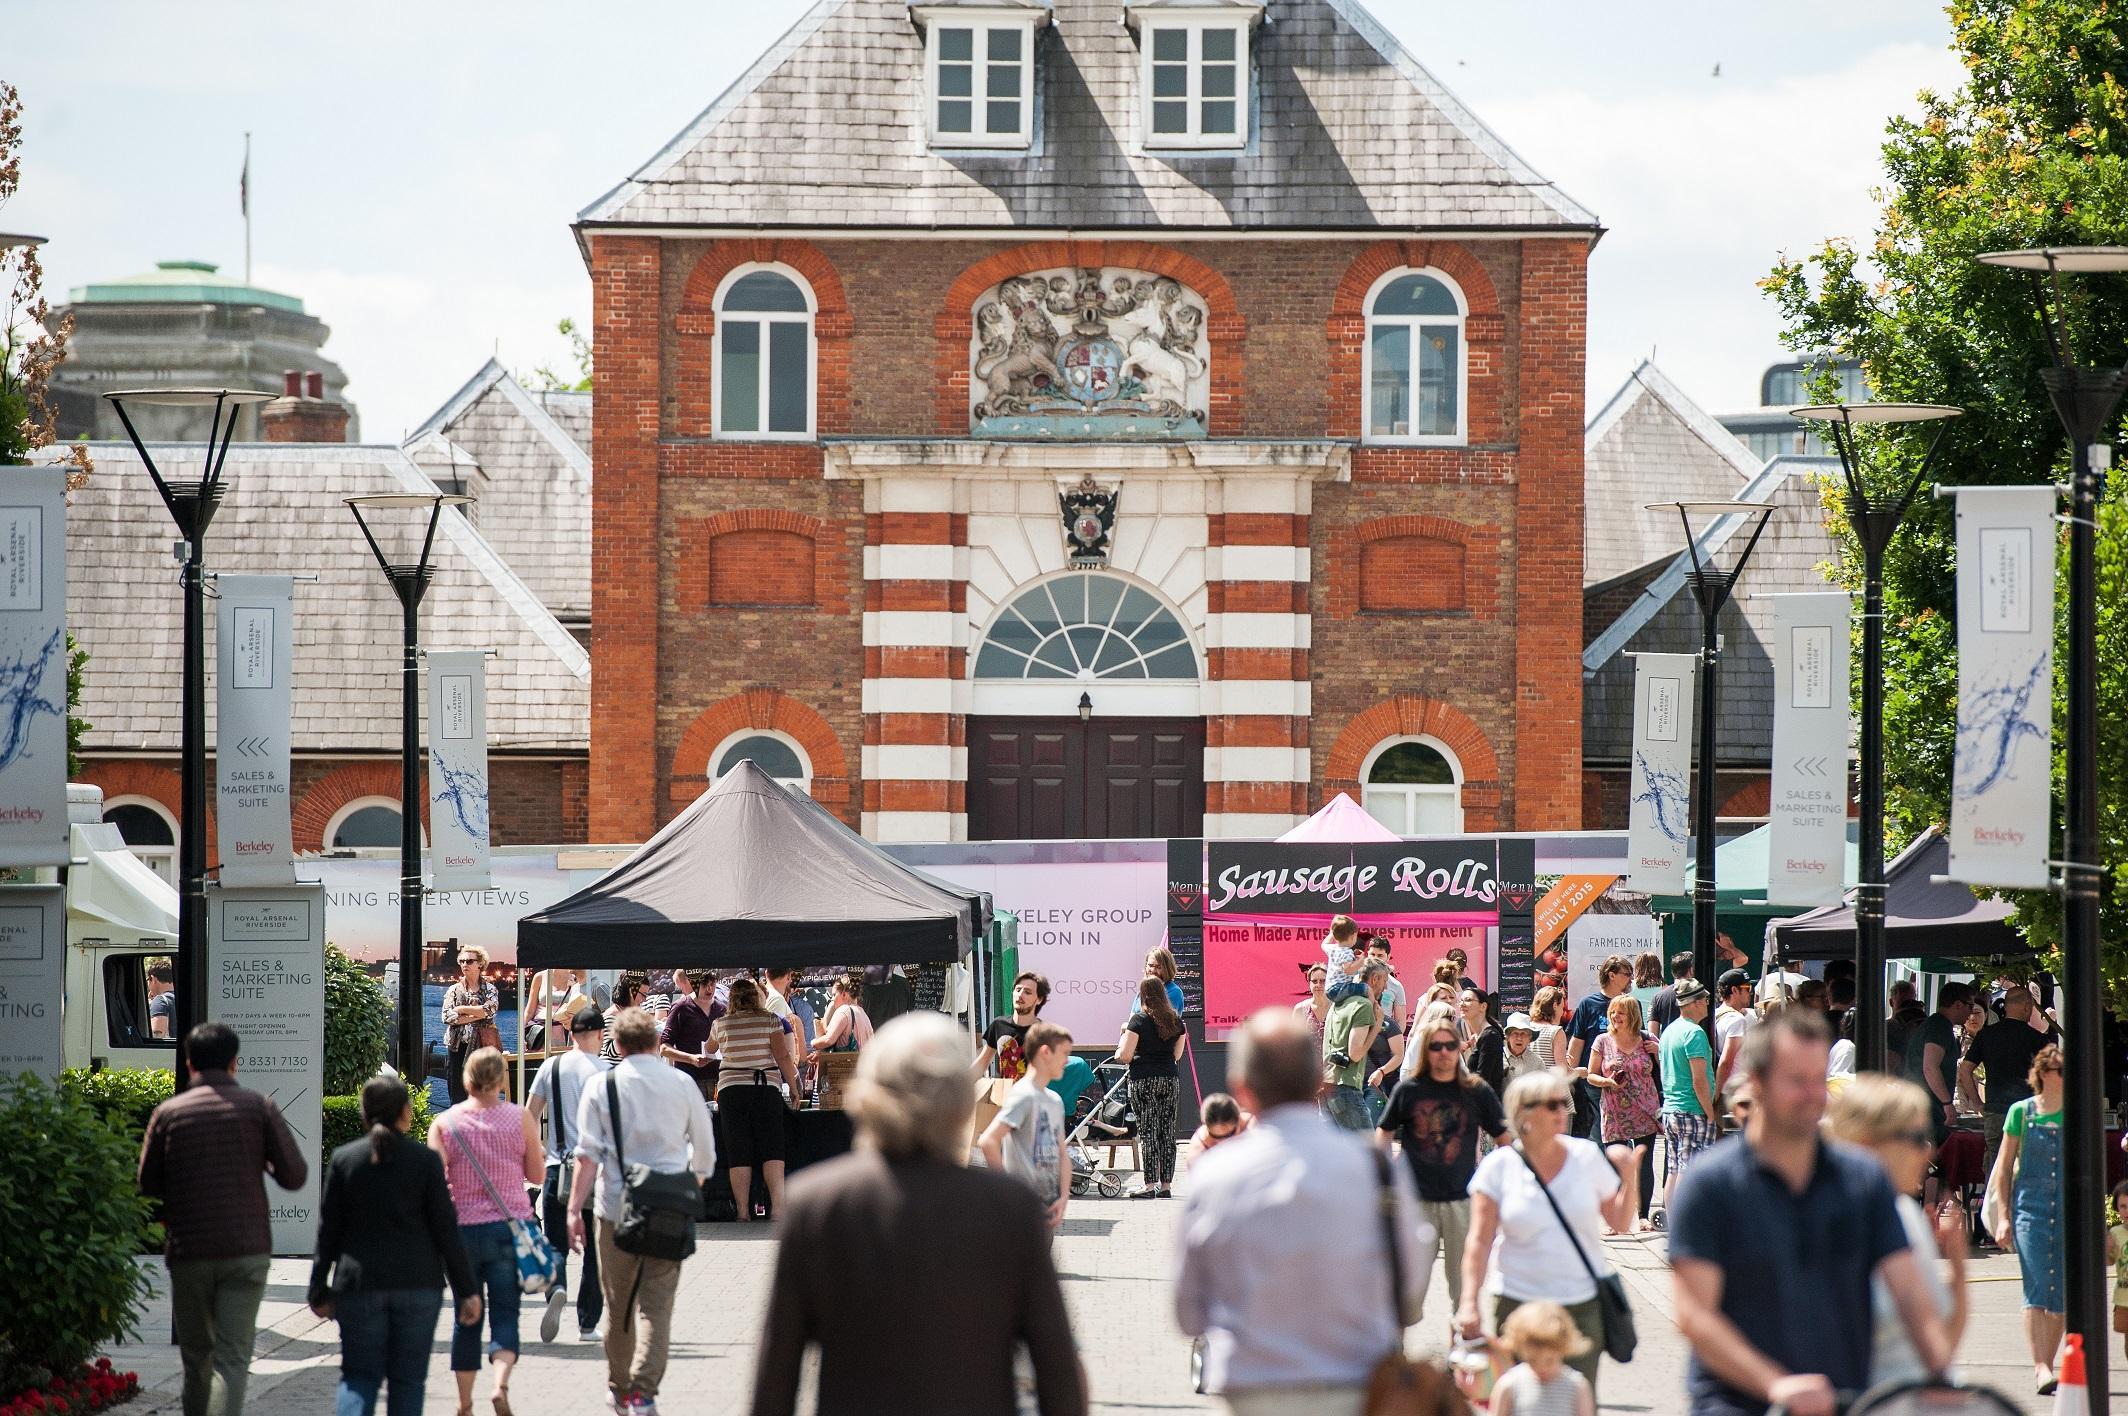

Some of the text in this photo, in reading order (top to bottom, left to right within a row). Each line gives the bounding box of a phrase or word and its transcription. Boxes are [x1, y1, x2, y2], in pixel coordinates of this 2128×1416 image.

[231, 771, 275, 781] SALES &
[221, 784, 285, 794] MARKETING
[1786, 790, 1832, 800] SALES &
[238, 798, 268, 808] SUITE
[1776, 803, 1842, 814] MARKETING
[1792, 817, 1825, 827] SUITE
[236, 840, 275, 854] Berkeley
[445, 856, 476, 867] Berkeley
[1641, 857, 1672, 869] Berkeley
[1786, 858, 1827, 874] Berkeley
[1168, 881, 1202, 893] Menu
[1210, 857, 1496, 911] Sausage Rolls
[1499, 881, 1534, 892] Menu
[326, 891, 529, 906] NING RER VIEWS
[1537, 882, 1579, 922] WILL BE HERE
[1544, 901, 1570, 932] JULY
[1569, 881, 1594, 907] 2015
[1011, 909, 1152, 923] KELEY GROUP
[0, 926, 27, 934] ENAL
[1209, 925, 1250, 943] Home
[1254, 925, 1292, 942] Made
[1296, 927, 1330, 941] Artis
[1358, 927, 1396, 939] akes
[1399, 927, 1435, 939] From
[1440, 926, 1473, 938] Kent
[1082, 932, 1100, 945] IN
[1589, 937, 1632, 948] FARMERS
[222, 960, 284, 972] SALES &
[222, 973, 312, 985] MARKETING
[222, 987, 265, 999] SUITE
[1055, 980, 1138, 995] CROSSR
[1211, 1015, 1240, 1023] Talk
[249, 1056, 276, 1066] 8331
[281, 1056, 308, 1066] 7130
[267, 1204, 311, 1223] erkeley
